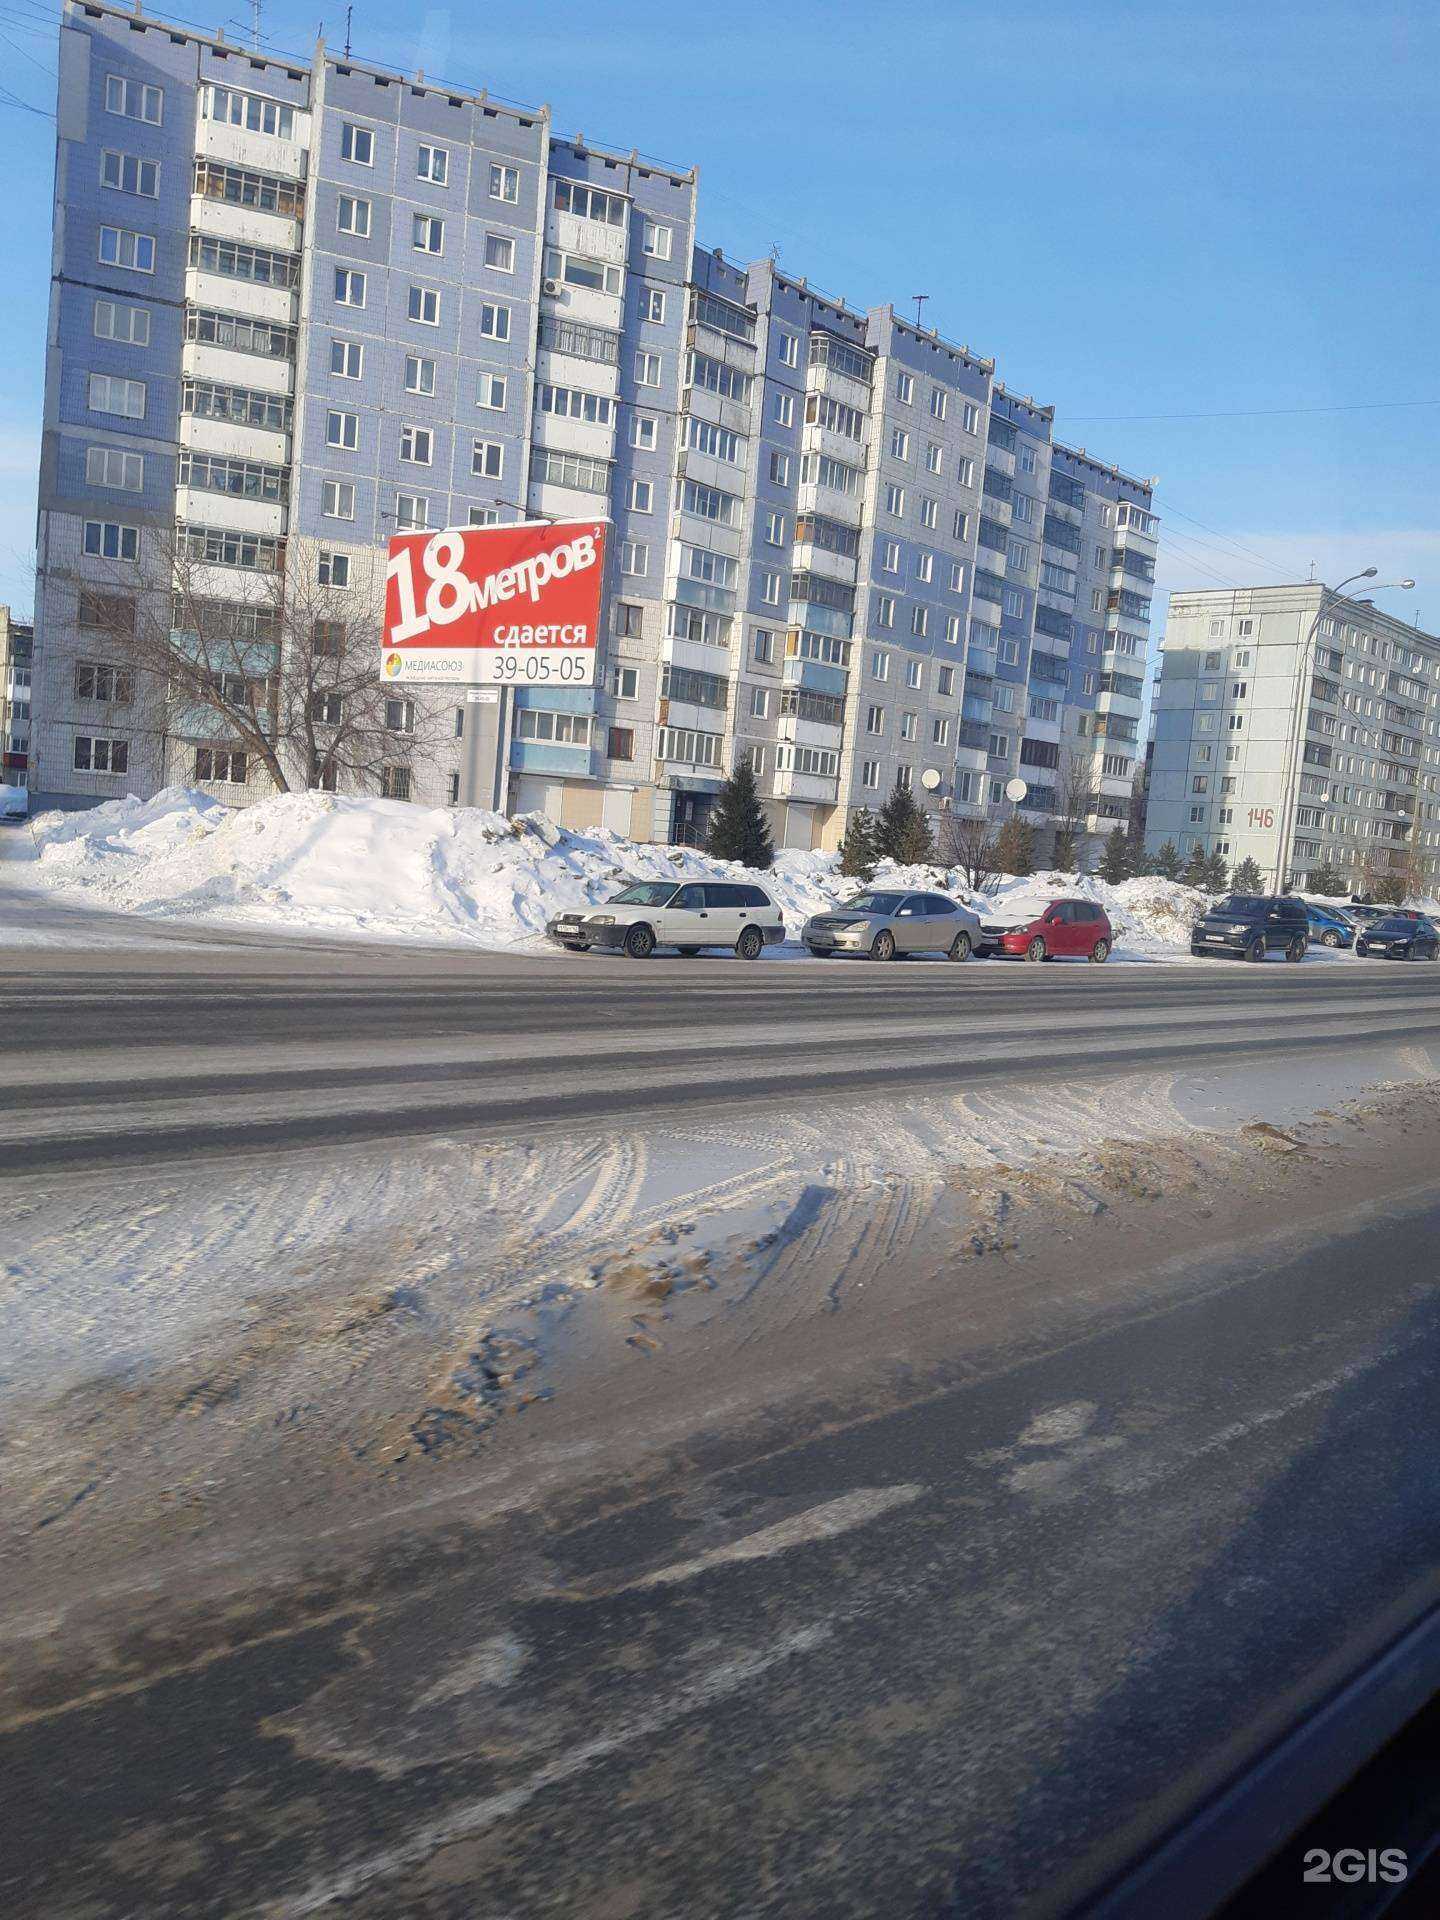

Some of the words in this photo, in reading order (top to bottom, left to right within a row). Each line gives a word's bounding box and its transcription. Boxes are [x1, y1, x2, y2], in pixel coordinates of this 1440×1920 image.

[387, 531, 472, 644] 18
[493, 624, 588, 648] сдается
[404, 658, 463, 673] МЕДИАСОЮЗ
[492, 655, 586, 680] 39-05-05
[1248, 808, 1274, 828] 146
